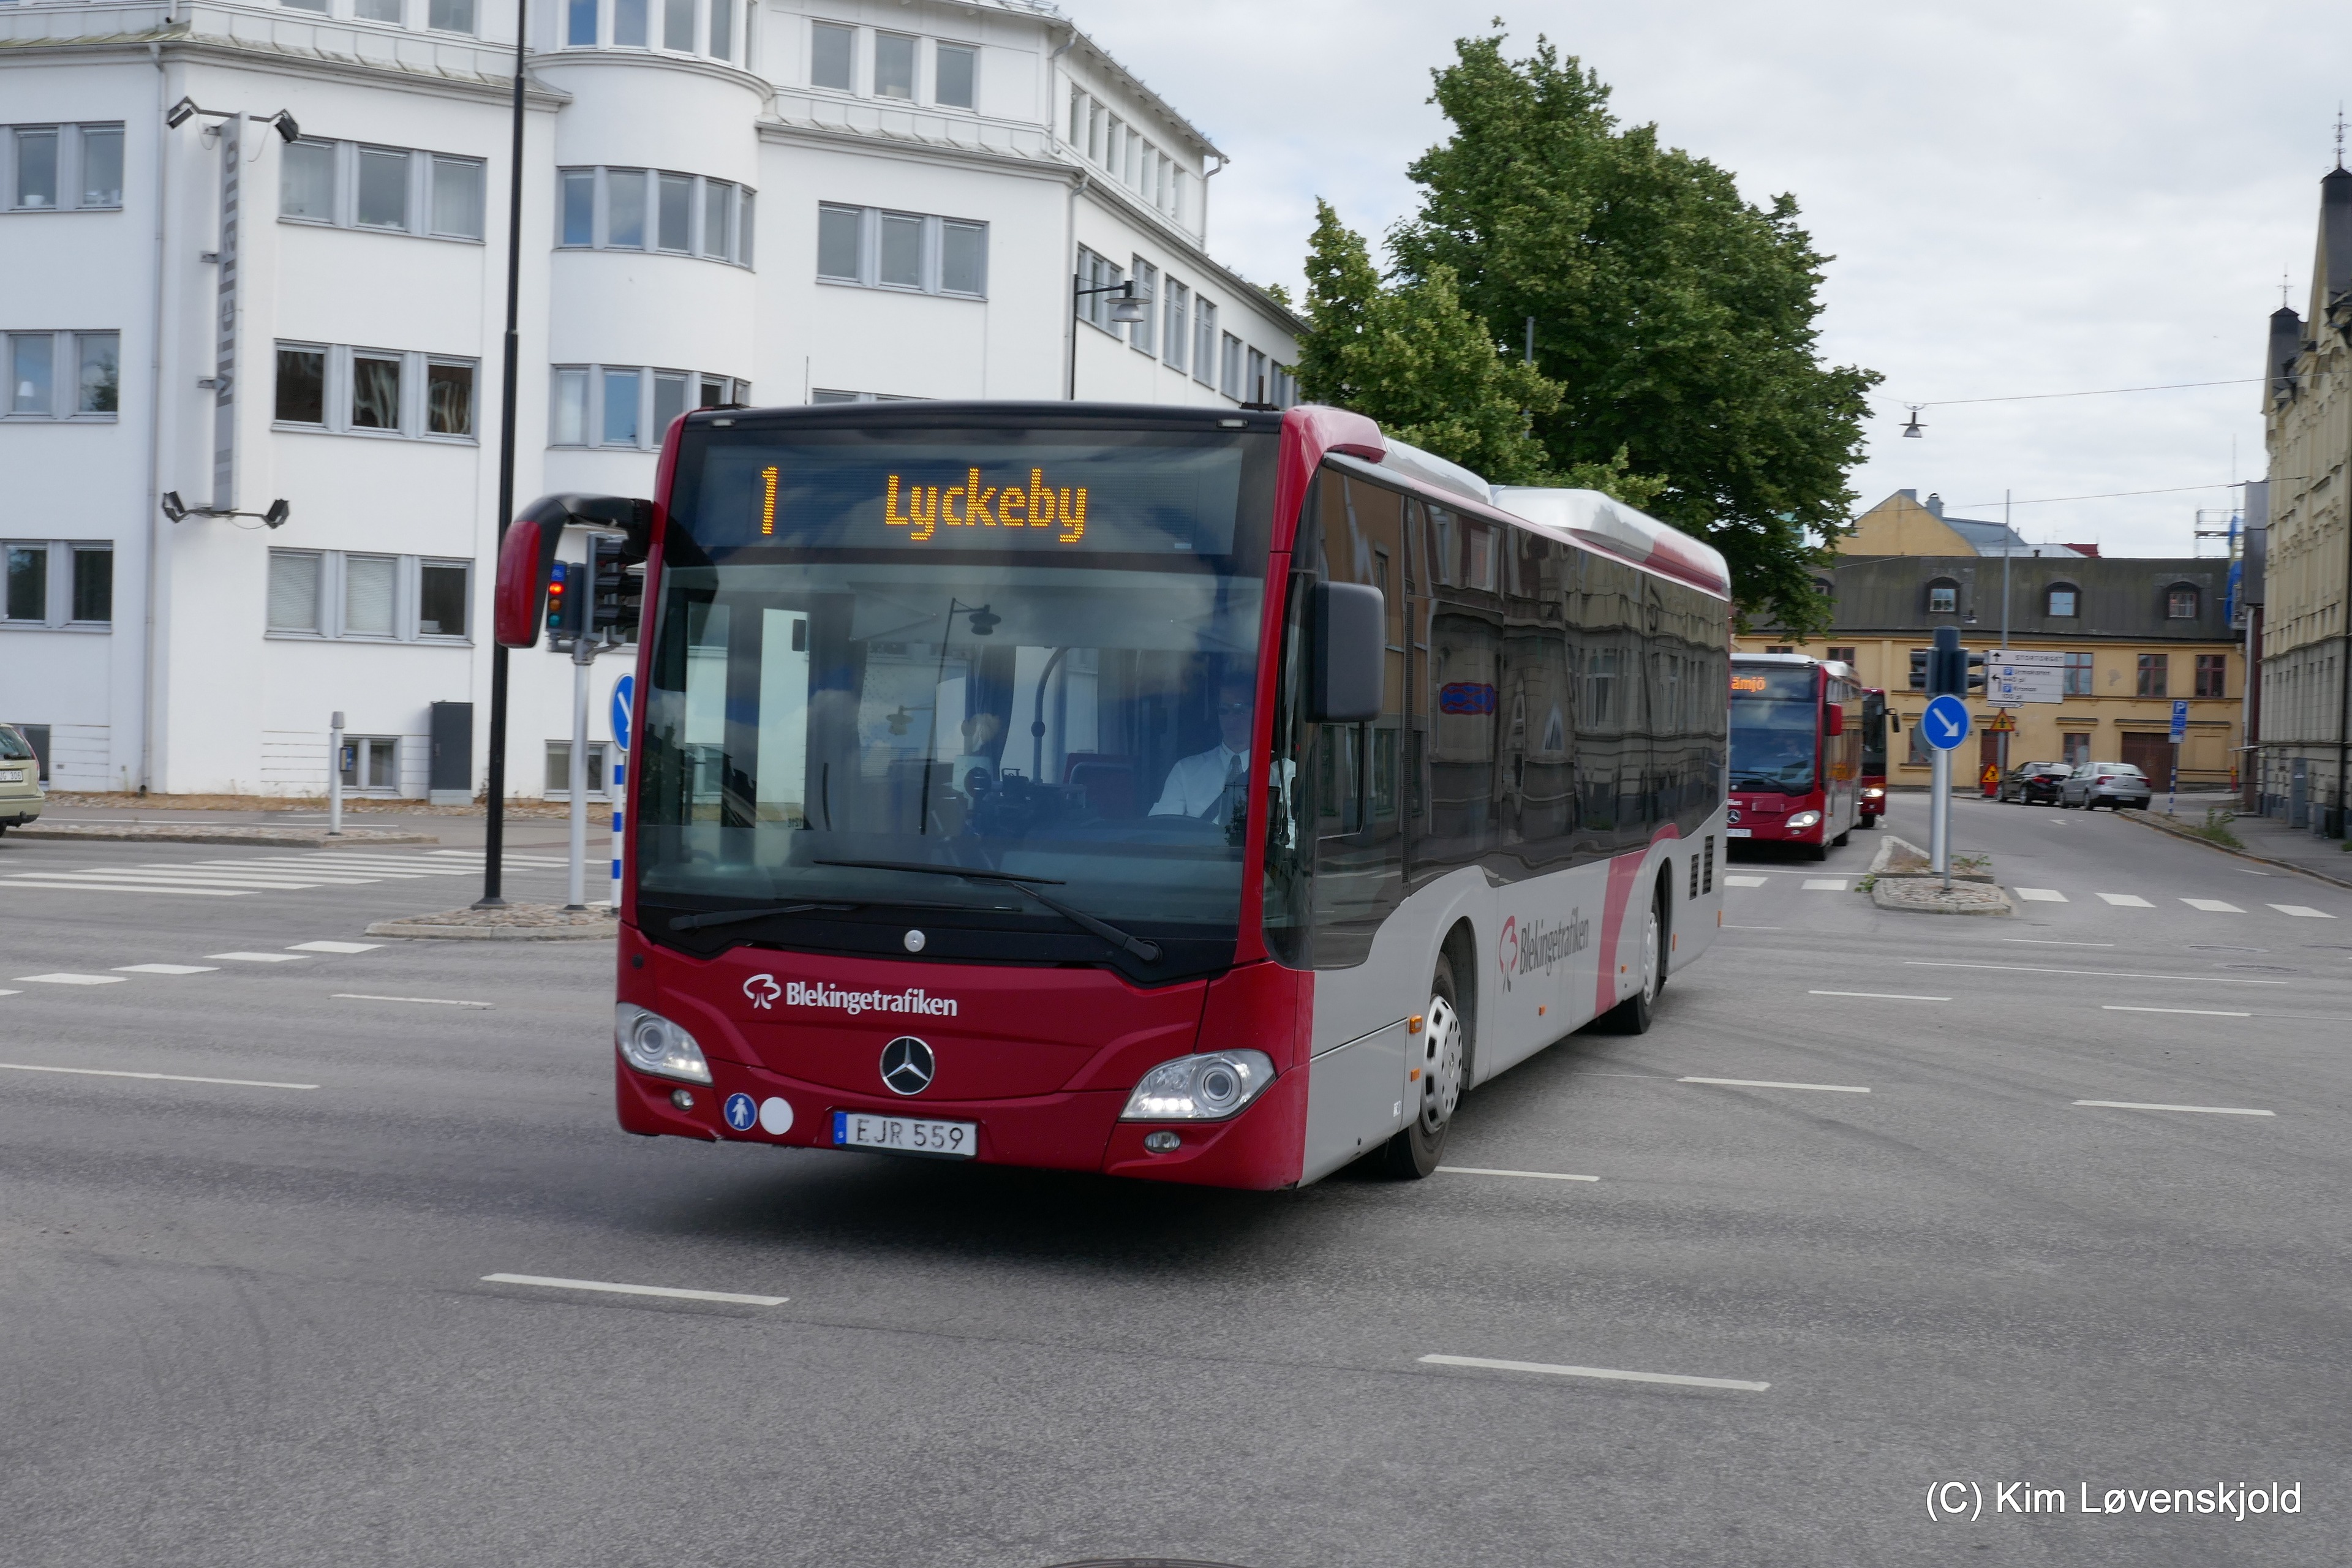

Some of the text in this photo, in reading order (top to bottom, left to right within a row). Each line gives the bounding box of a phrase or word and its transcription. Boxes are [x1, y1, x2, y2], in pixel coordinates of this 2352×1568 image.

[216, 140, 238, 409] Michano
[761, 466, 1087, 543] 1 Lyckeby
[1731, 676, 1766, 693] ämjö
[1520, 907, 1589, 976] Blekingetrafiken
[786, 981, 958, 1016] Blekingetrafiken
[856, 1118, 903, 1146] EJR
[913, 1123, 963, 1150] 559
